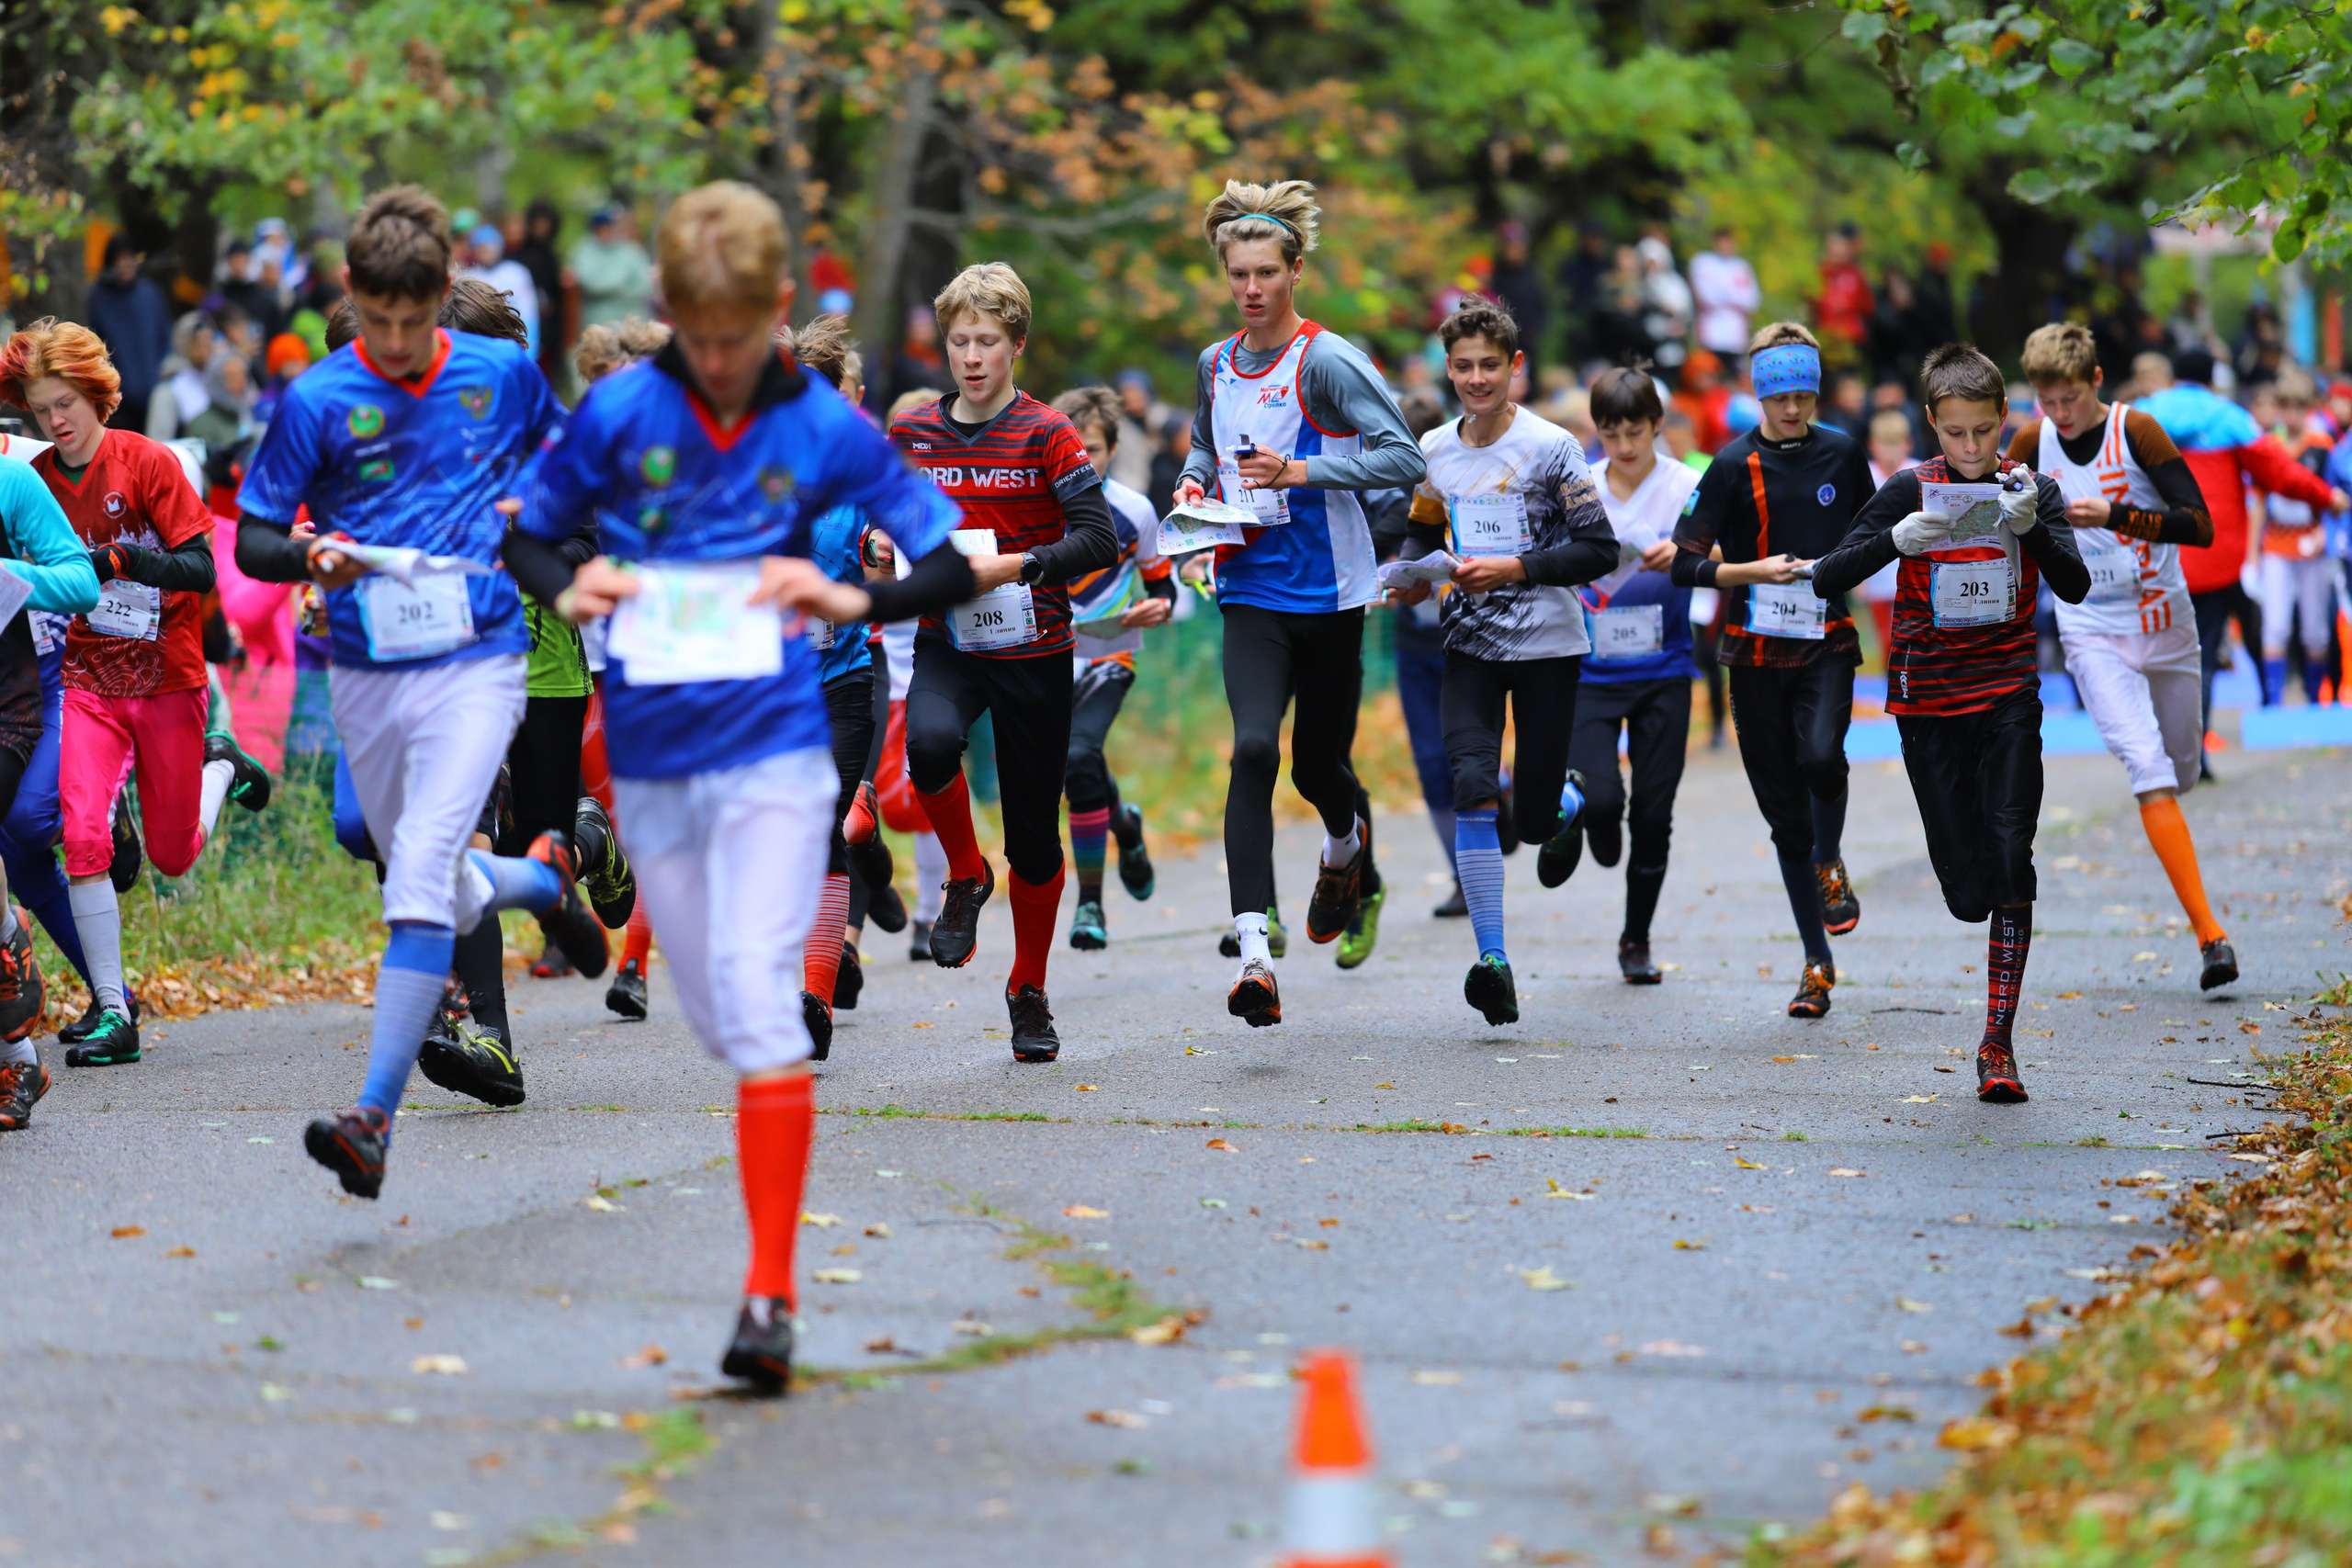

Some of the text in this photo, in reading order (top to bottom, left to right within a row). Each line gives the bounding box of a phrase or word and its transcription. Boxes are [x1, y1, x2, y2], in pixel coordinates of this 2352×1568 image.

[918, 467, 1039, 489] ORD WEST
[1238, 489, 1255, 502] 211
[1474, 520, 1500, 534] 206
[2093, 570, 2114, 582] 221
[1960, 581, 1989, 597] 203
[106, 600, 131, 617] 222
[398, 601, 434, 624] 202
[1771, 601, 1797, 616] 204
[973, 610, 1003, 627] 208
[1612, 626, 1637, 641] 205
[2002, 916, 2015, 963] WEST
[1995, 971, 2010, 1025] NORD
